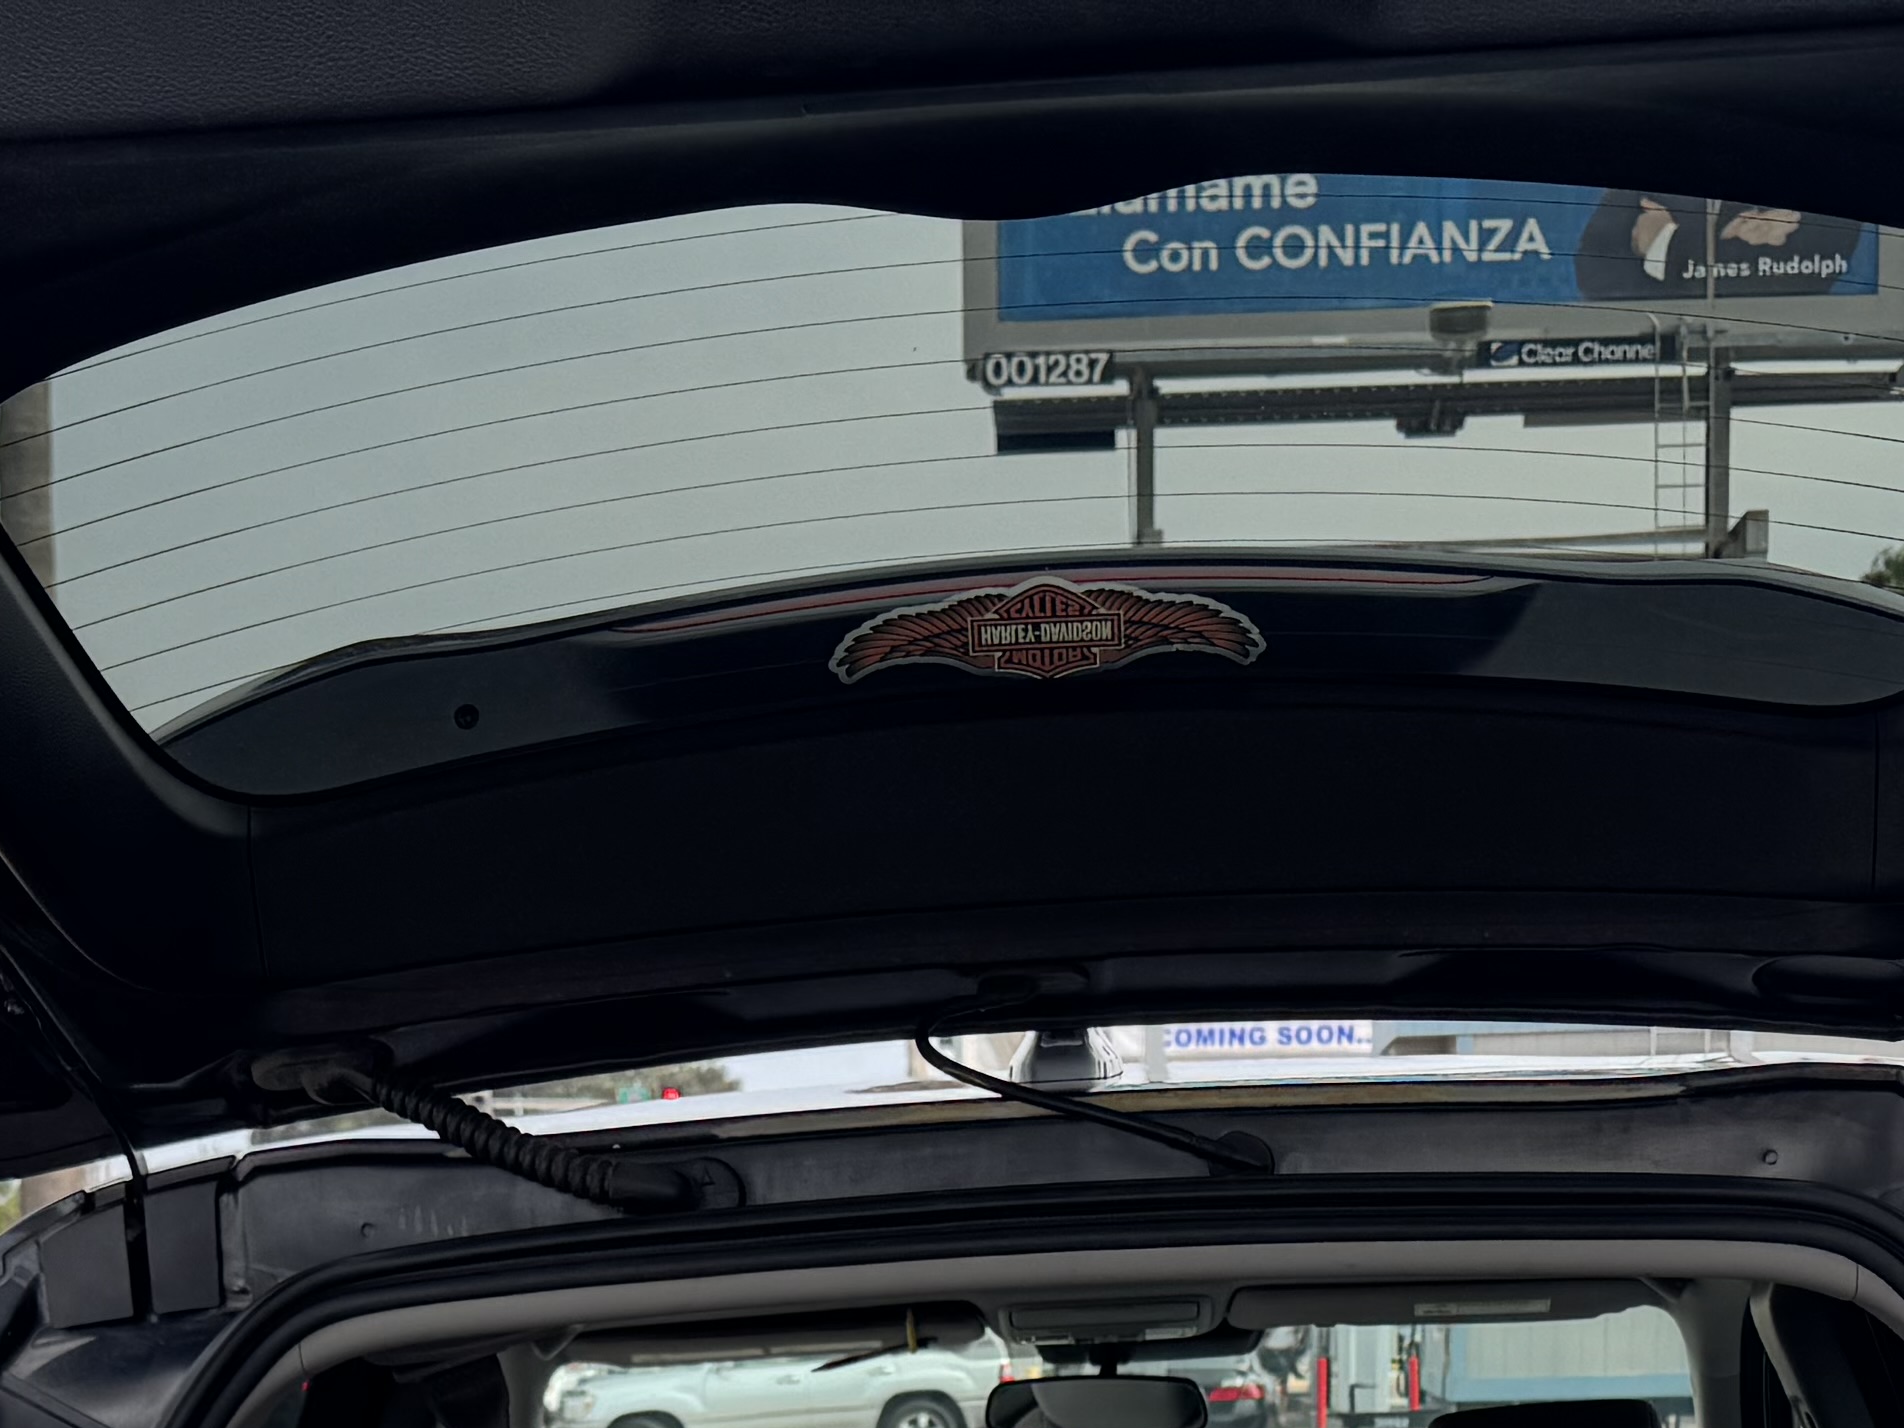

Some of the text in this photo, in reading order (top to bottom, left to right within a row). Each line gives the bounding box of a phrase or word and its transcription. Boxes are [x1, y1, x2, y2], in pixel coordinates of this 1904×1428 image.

[1123, 218, 1552, 274] Con CONFIANZA
[1758, 253, 1848, 277] Rudolph
[1521, 341, 1658, 364] Clear Channe
[986, 354, 1110, 386] 001287
